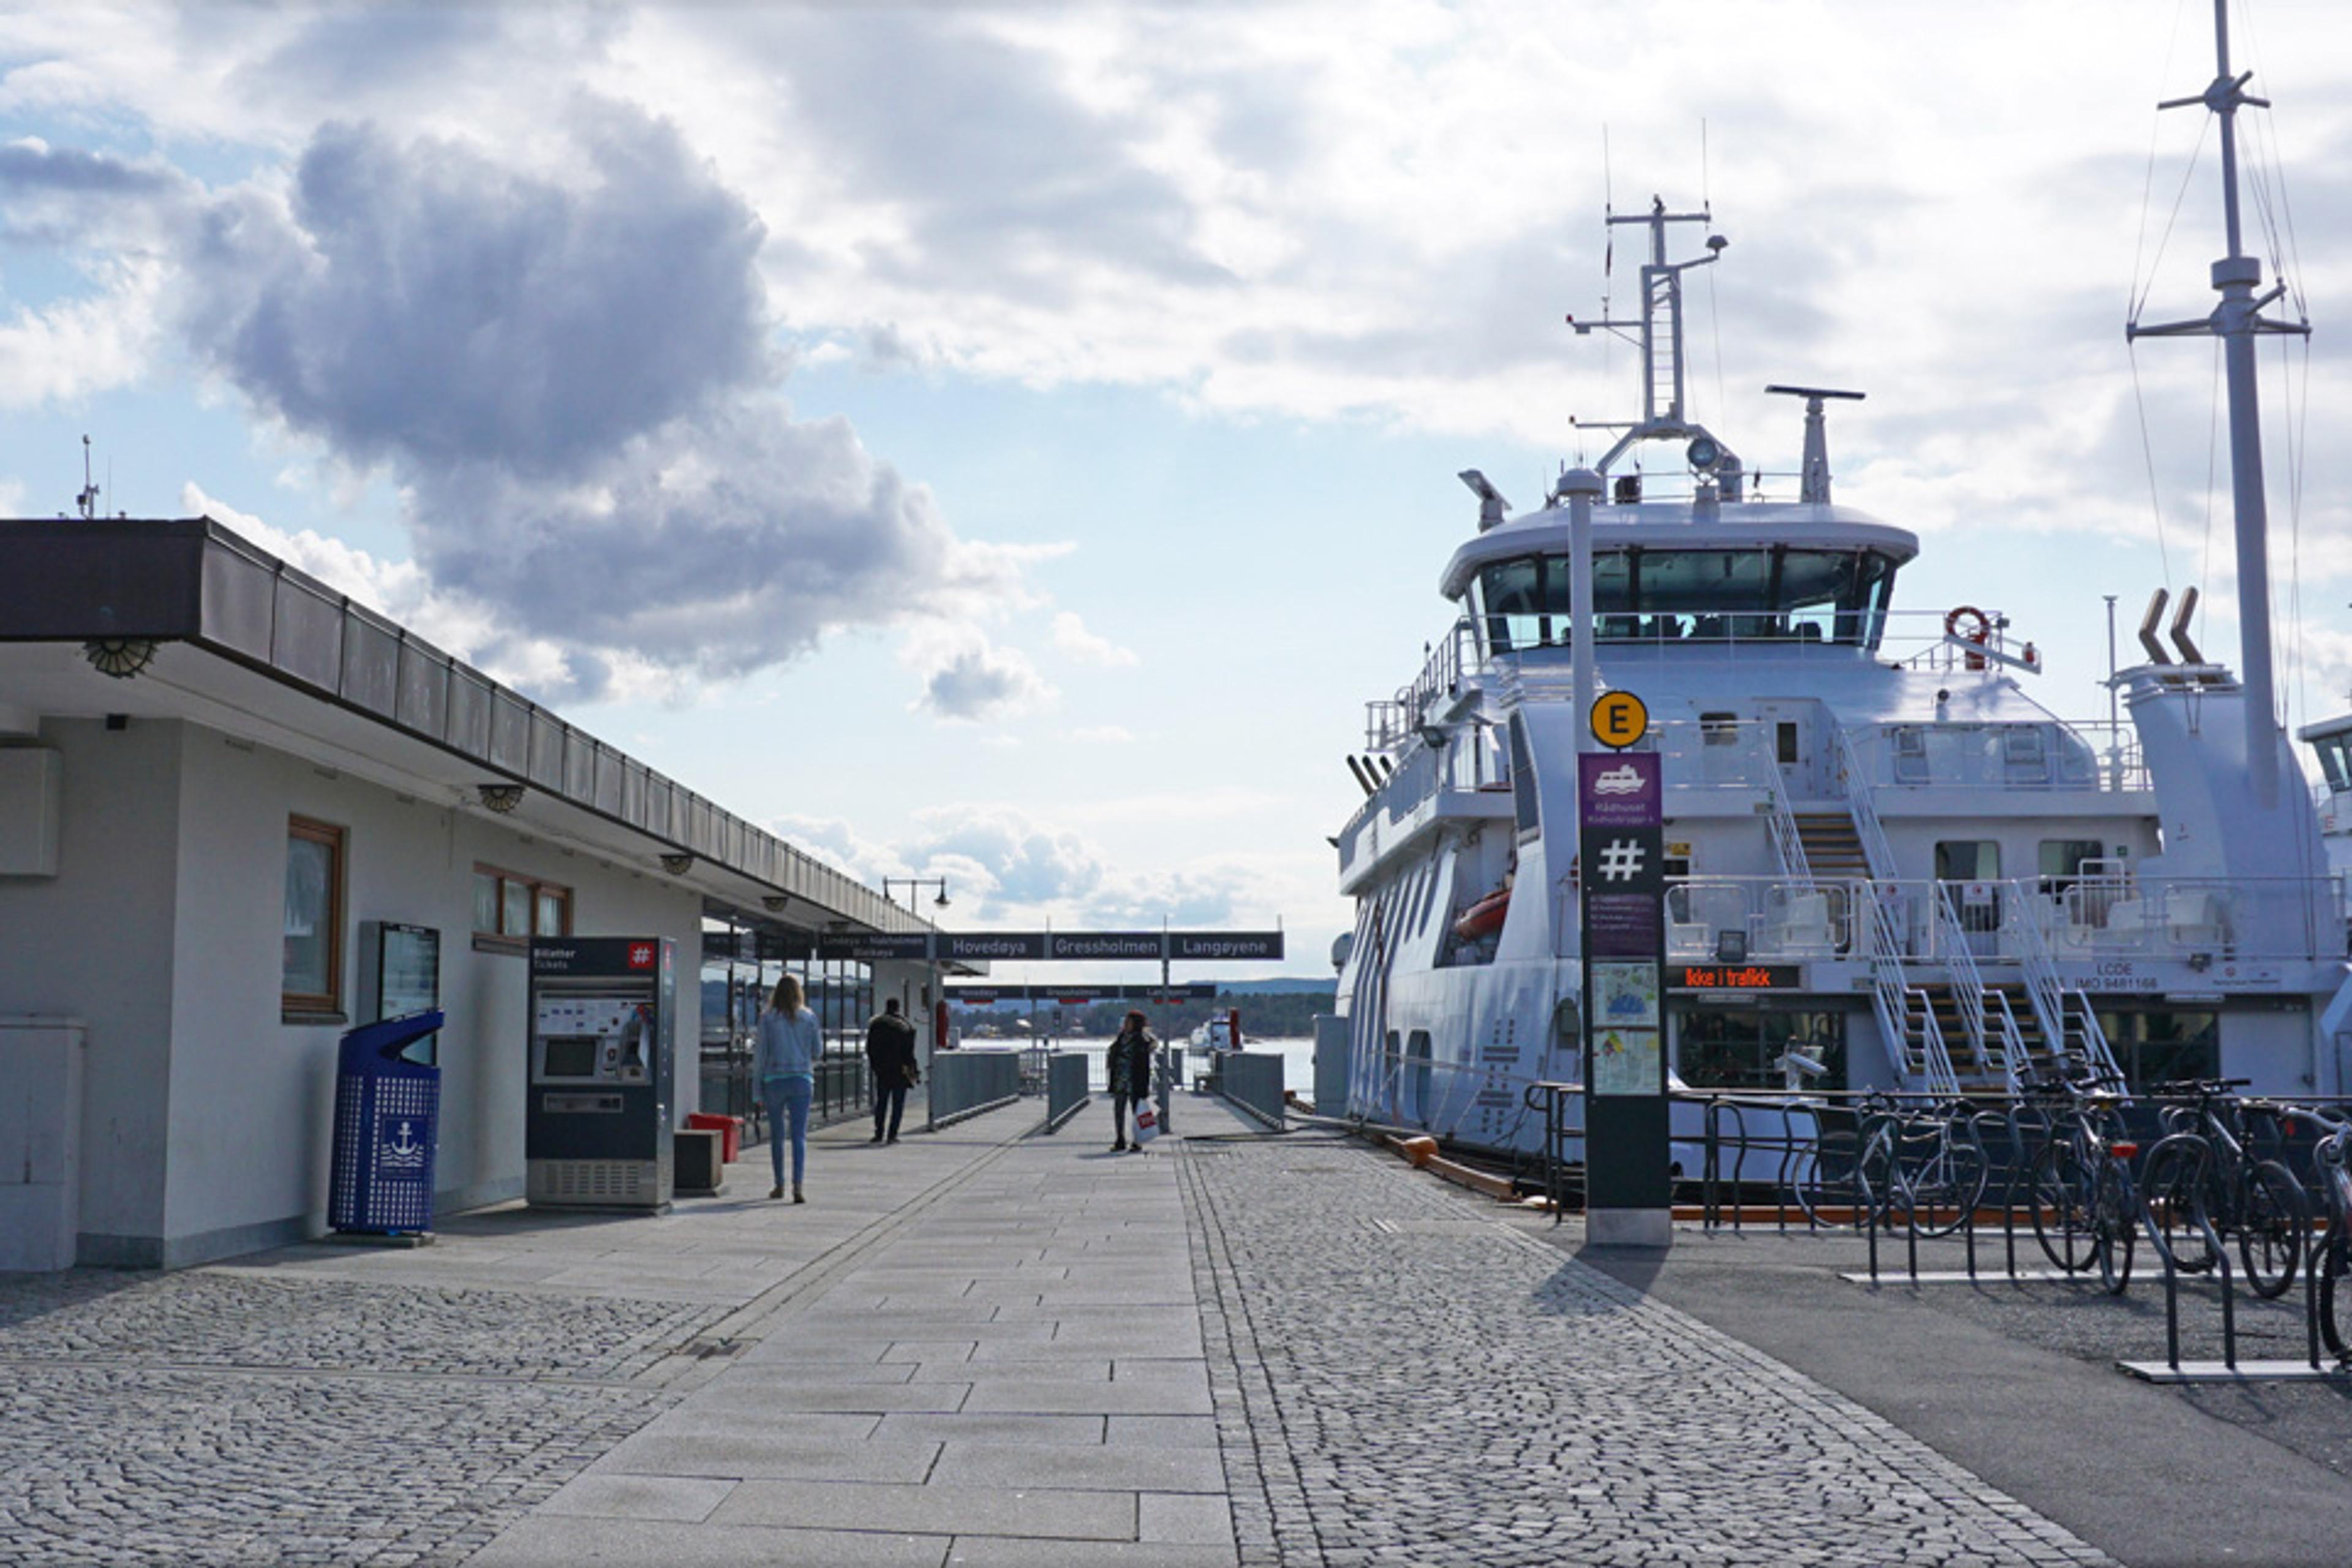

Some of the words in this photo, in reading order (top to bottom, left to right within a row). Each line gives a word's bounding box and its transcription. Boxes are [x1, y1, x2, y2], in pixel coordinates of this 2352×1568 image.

[1609, 704, 1630, 734] E
[952, 939, 1027, 956] Hovedøya
[1055, 938, 1158, 954] Gressholmen
[1183, 938, 1268, 956] Langøyene
[1725, 968, 1771, 987] trafikk
